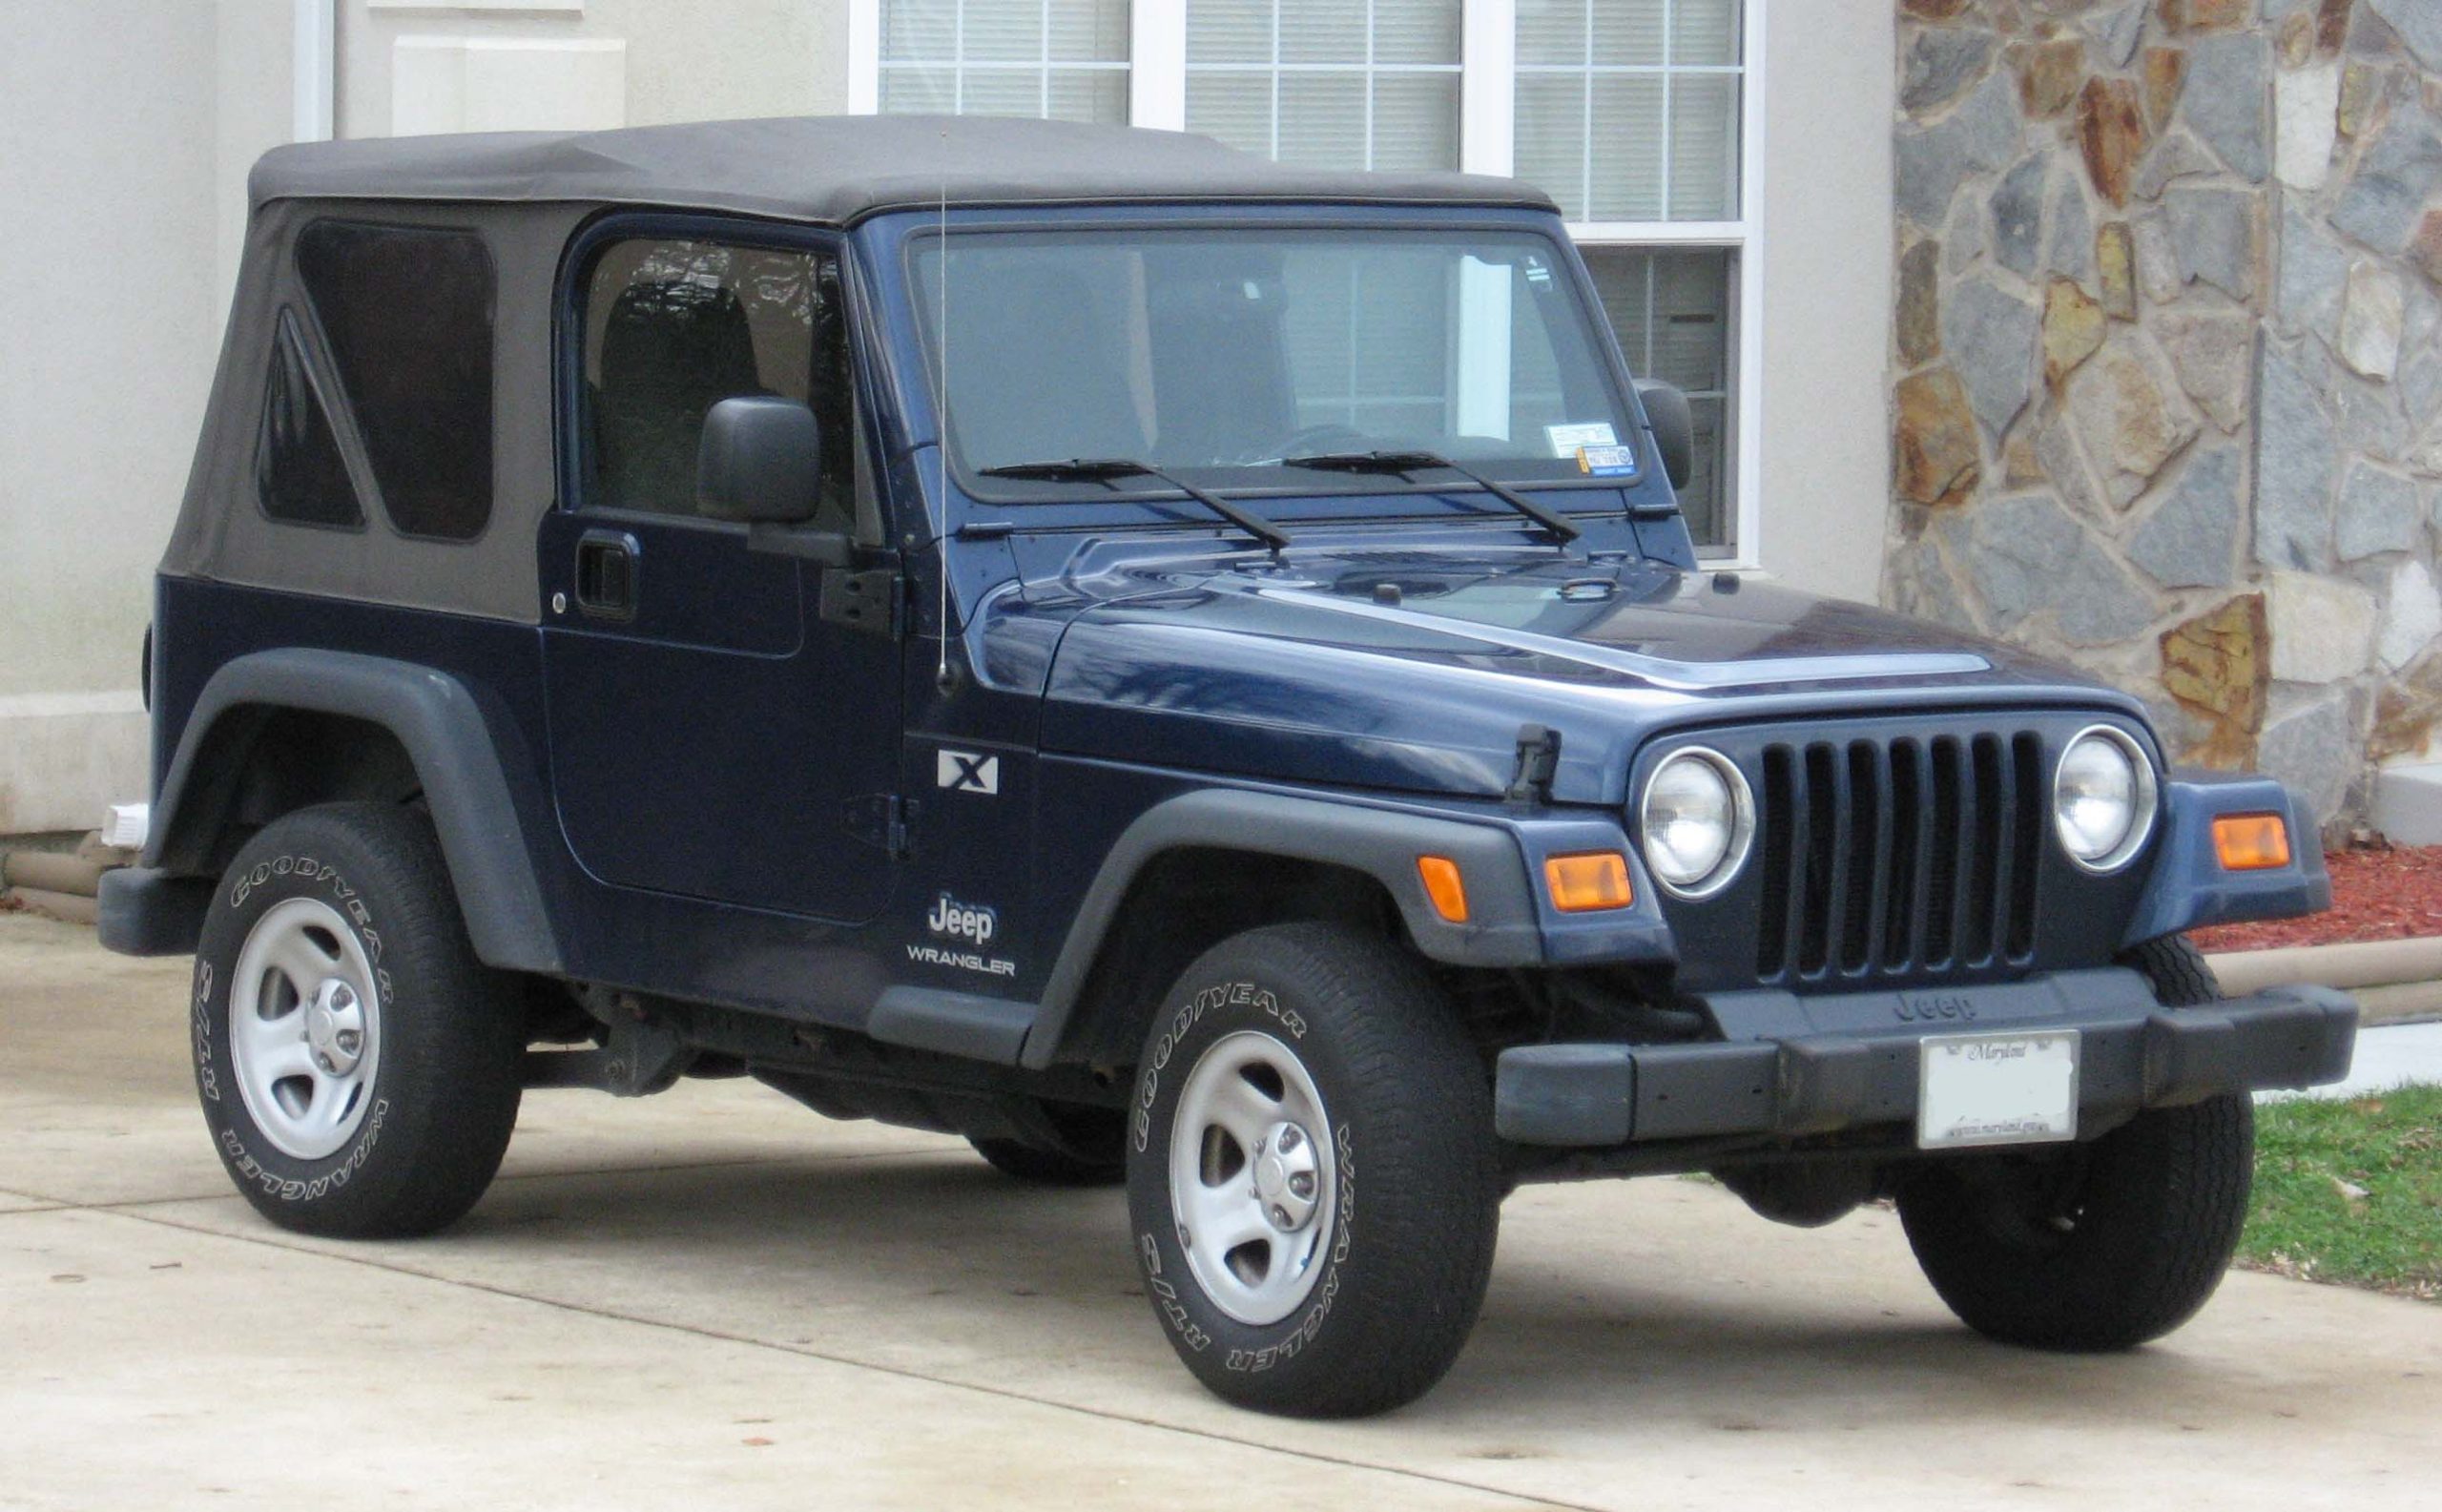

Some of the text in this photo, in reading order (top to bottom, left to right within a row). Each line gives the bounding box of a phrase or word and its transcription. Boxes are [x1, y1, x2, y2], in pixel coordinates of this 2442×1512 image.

[949, 751, 995, 791] X
[230, 855, 394, 1005] GOODYEAR
[928, 897, 994, 945] Jeep
[906, 944, 1016, 977] WRANGLER
[1893, 992, 1977, 1022] Jeep
[1135, 983, 1308, 1152] GOODYEAR
[1968, 1043, 2026, 1064] Maryland
[221, 1099, 389, 1201] WRANGLER
[1225, 1122, 1356, 1373] WRANGLER
